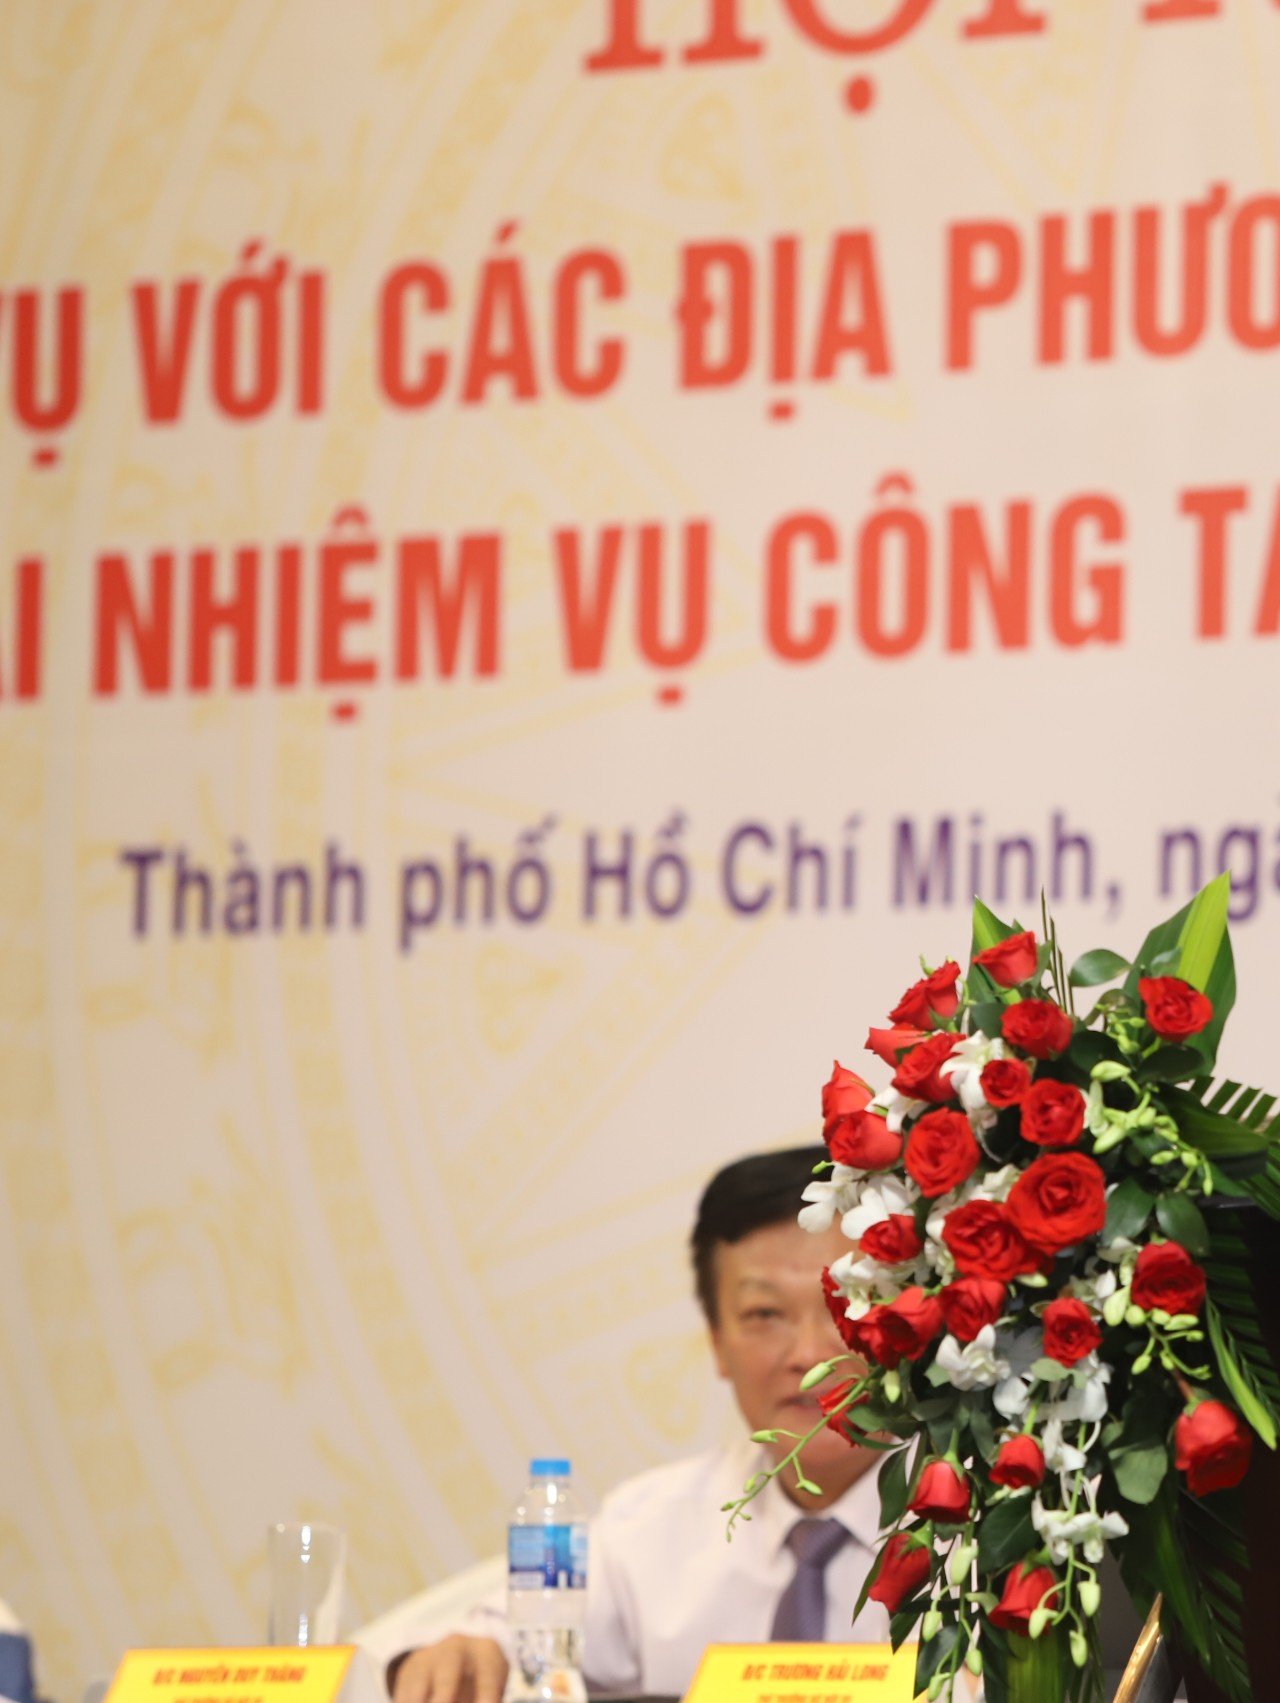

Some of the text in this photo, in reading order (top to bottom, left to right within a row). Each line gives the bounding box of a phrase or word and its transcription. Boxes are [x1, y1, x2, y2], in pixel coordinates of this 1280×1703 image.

[130, 239, 328, 427] VỚI
[376, 220, 627, 412] CÁC
[674, 229, 892, 424] ĐỊA
[92, 506, 503, 723] NHIỆM
[553, 520, 710, 707] VỤ
[765, 473, 1126, 664] CÔNG
[121, 838, 366, 938] Thành
[400, 815, 558, 955] phố
[582, 810, 692, 921] Hồ
[720, 815, 860, 918] Chí
[893, 808, 1121, 924] Minh,
